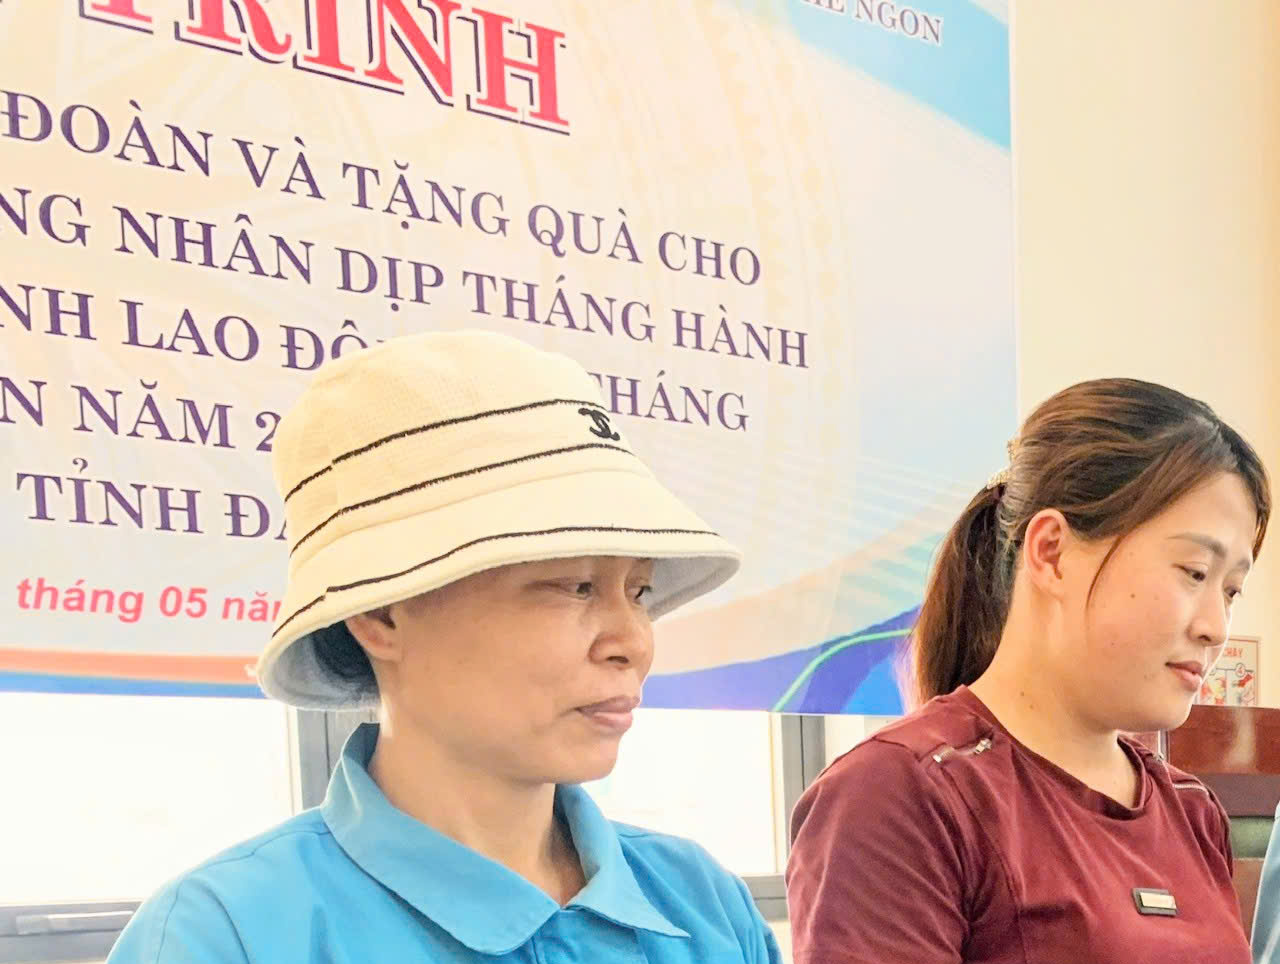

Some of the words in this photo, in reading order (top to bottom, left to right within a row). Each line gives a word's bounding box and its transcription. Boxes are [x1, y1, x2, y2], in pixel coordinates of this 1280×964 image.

[853, 0, 941, 43] NGON
[0, 90, 213, 177] ĐOÀN
[232, 136, 326, 200] VÀ
[341, 159, 510, 238] TẶNG
[527, 203, 644, 265] QUÀ
[658, 231, 761, 286] CHO
[112, 206, 315, 285] NHÂN
[334, 246, 445, 313] DỊP
[461, 271, 656, 343] THÁNG
[671, 304, 809, 369] HÀNH
[118, 299, 260, 363] LAO
[0, 376, 47, 427] N
[70, 379, 237, 449] NĂM
[16, 457, 205, 534] TỈNH
[16, 577, 145, 624] tháng
[159, 586, 208, 619] 05
